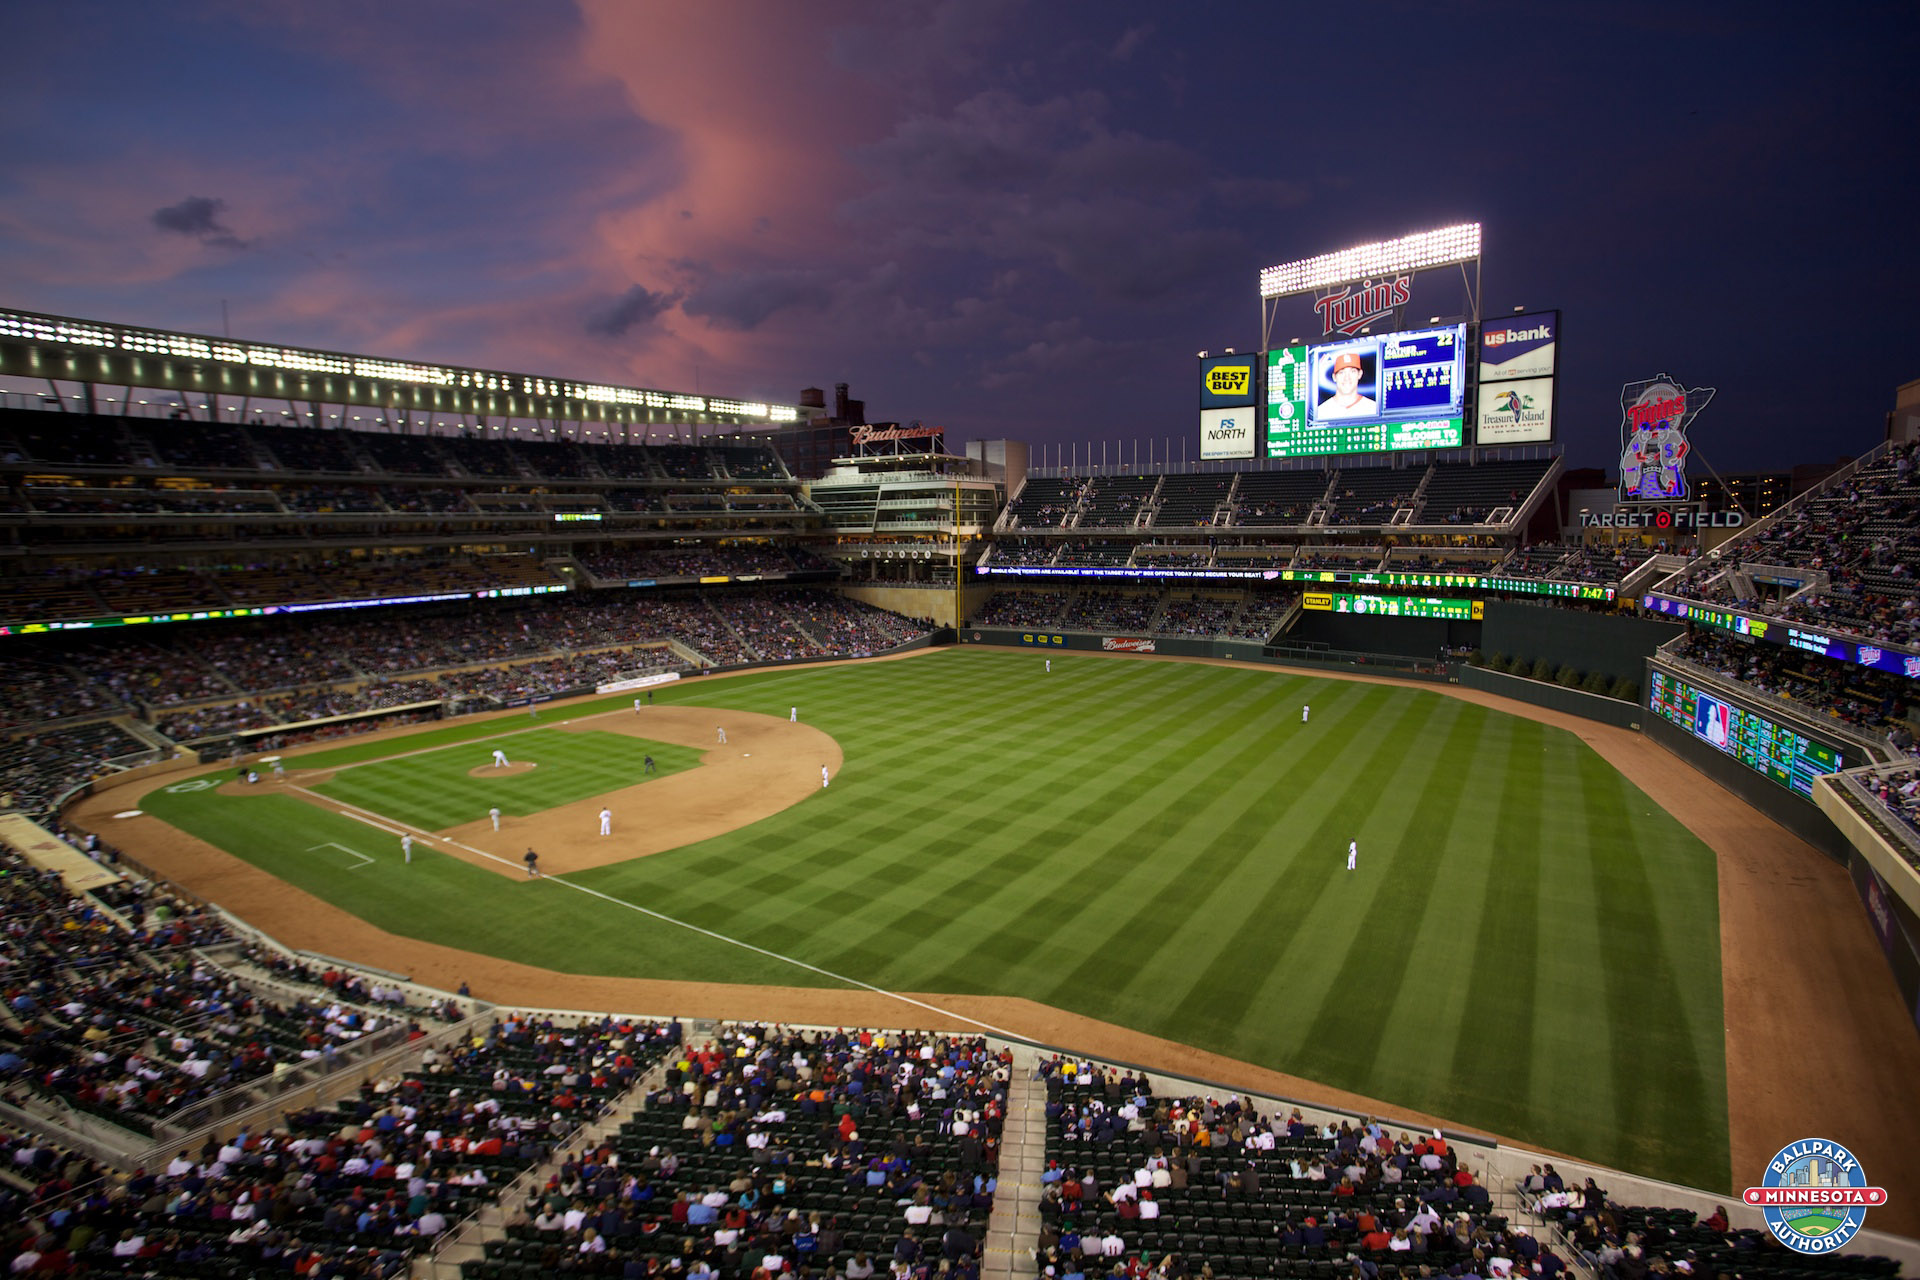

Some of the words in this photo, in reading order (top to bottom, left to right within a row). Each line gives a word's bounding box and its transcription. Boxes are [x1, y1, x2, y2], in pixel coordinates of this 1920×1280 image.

[1314, 276, 1410, 336] Twins
[1437, 334, 1453, 346] 22
[1212, 372, 1247, 380] BEST
[1482, 414, 1513, 424] Treasure
[1522, 410, 1544, 421] Island
[1628, 396, 1684, 432] Twins
[1220, 419, 1235, 428] FS
[849, 424, 944, 445] Budweiser
[1208, 429, 1245, 440] NORTH
[1393, 431, 1442, 441] WELCOME
[1443, 429, 1458, 438] TO
[1579, 513, 1653, 527] TARGET
[1675, 512, 1742, 527] FIELD
[1583, 588, 1602, 598] 7:47
[1104, 640, 1155, 650] Budweiser
[1858, 646, 1880, 666] Twins
[1796, 736, 1810, 748] OAK
